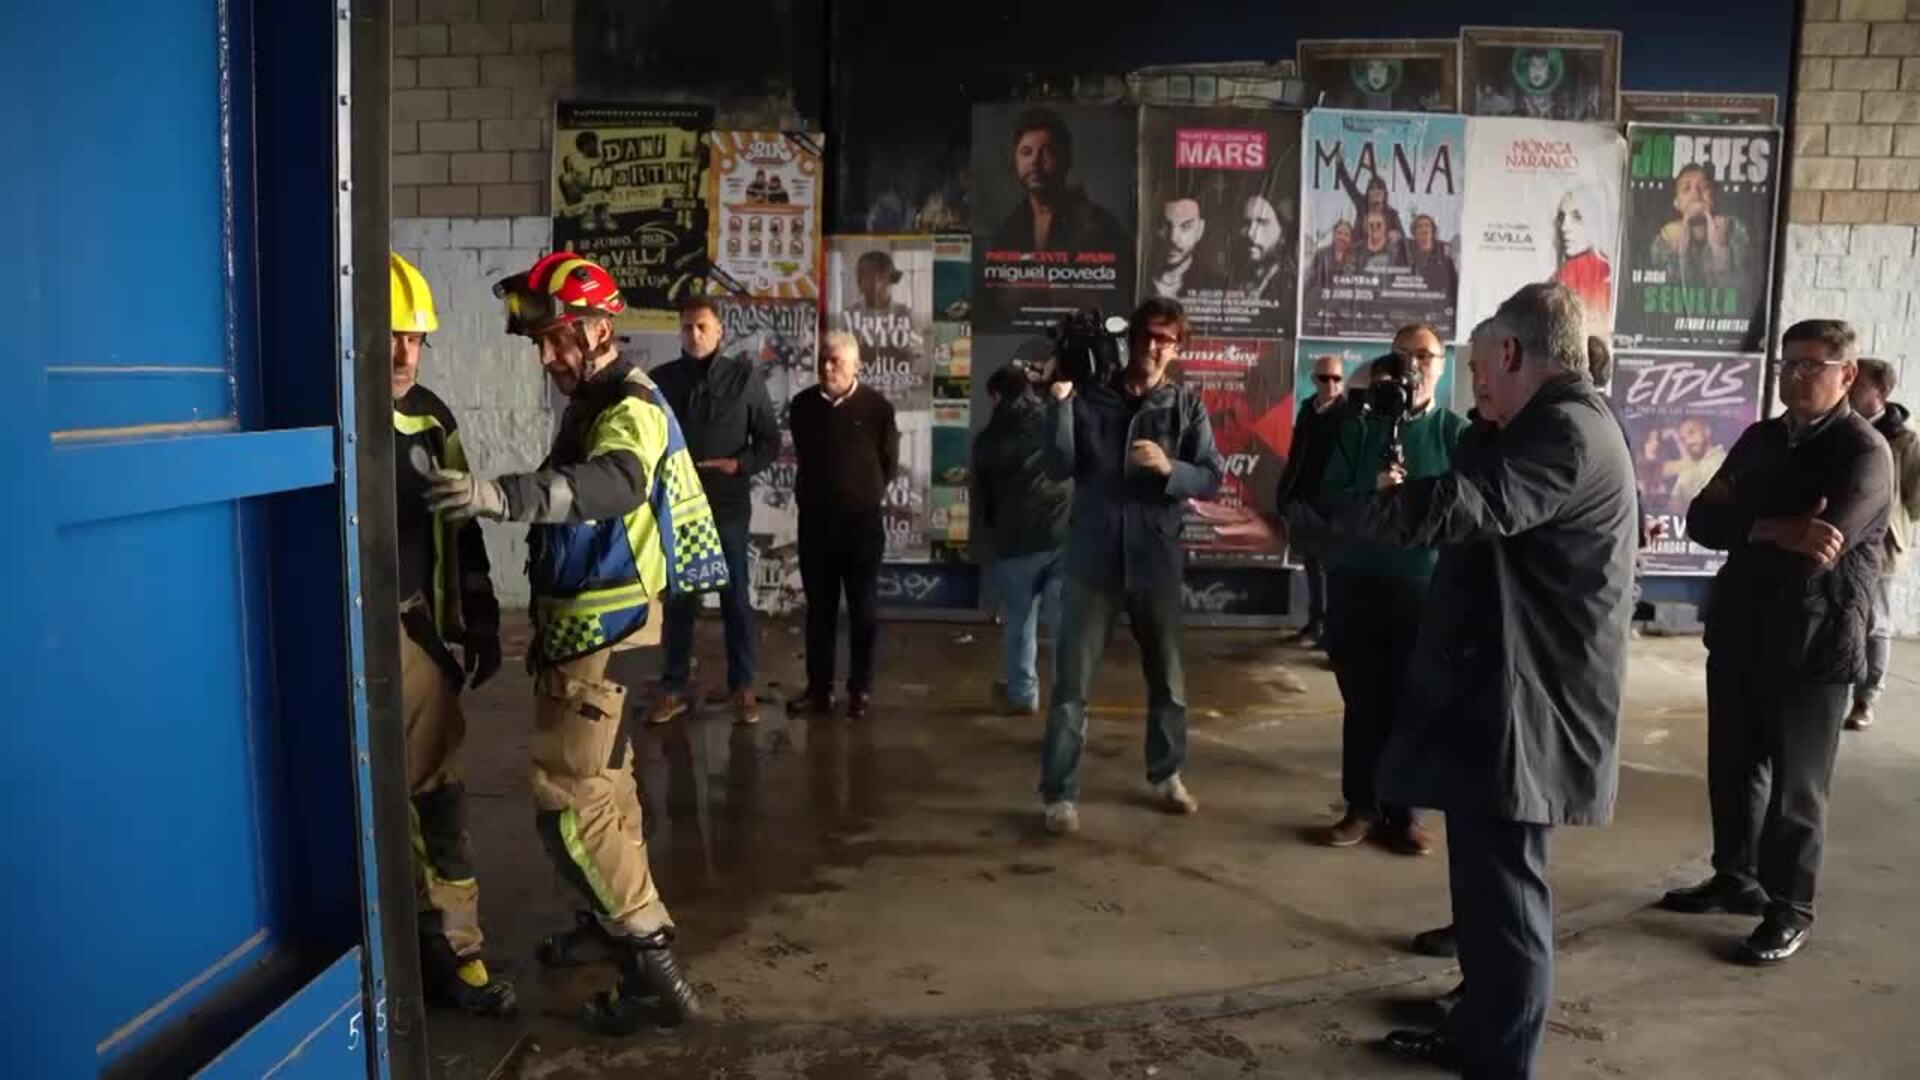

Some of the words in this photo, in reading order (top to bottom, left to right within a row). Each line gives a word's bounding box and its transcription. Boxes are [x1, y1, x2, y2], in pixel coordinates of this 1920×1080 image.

[1178, 140, 1264, 167] MARS
[1483, 231, 1534, 244] SEVILLA
[984, 264, 1045, 282] miguel
[1047, 266, 1117, 282] poveda
[1626, 361, 1751, 405] ETDLS
[347, 1011, 363, 1051] 5
